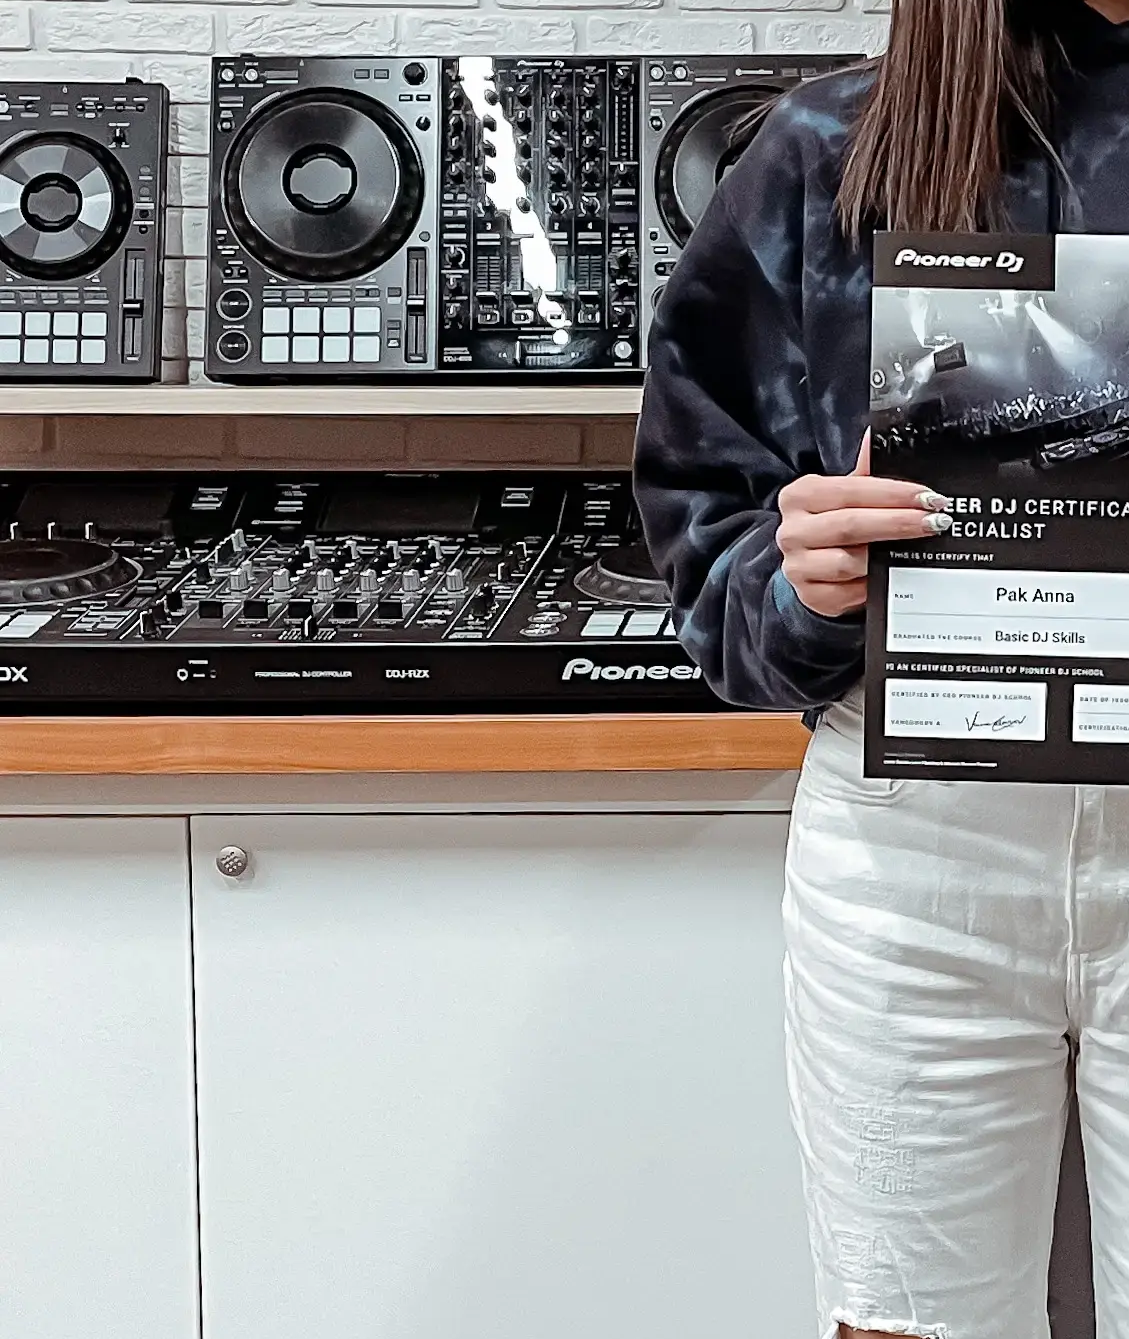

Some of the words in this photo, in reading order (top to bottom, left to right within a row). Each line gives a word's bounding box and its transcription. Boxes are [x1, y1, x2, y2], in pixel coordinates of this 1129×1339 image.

[894, 248, 992, 268] Pioneer
[990, 498, 1017, 515] DJ
[889, 550, 909, 559] THIS
[935, 553, 970, 561] CERTIFY
[996, 587, 1028, 602] Pak
[1032, 588, 1075, 603] Anna
[995, 630, 1029, 642] Basic
[1032, 632, 1048, 643] DJ
[1052, 631, 1086, 644] Skills
[911, 664, 954, 672] CERTIFIED
[956, 665, 1004, 674] SPECIALIST
